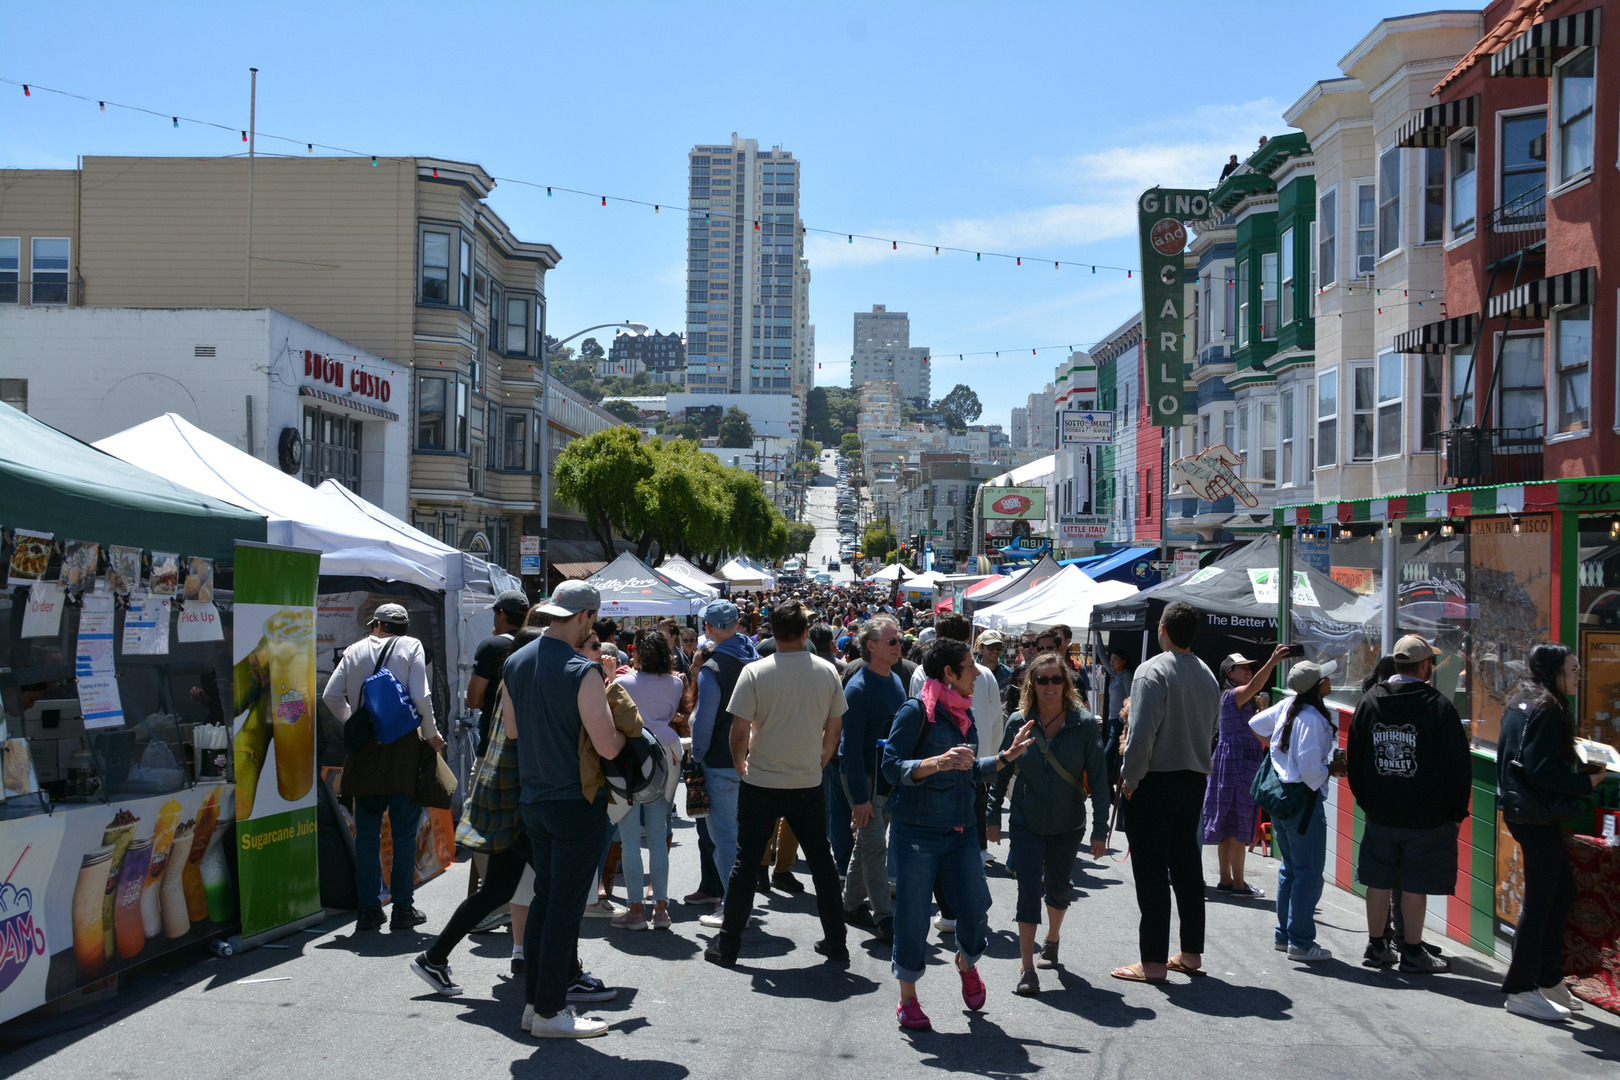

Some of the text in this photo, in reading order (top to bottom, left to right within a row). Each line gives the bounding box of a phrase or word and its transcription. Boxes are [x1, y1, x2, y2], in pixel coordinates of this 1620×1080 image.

[1142, 193, 1208, 214] GINO
[1154, 219, 1185, 246] and
[1158, 264, 1179, 415] CARLO
[305, 350, 391, 402] BUON GUSTO
[1177, 461, 1212, 482] PIZZA
[1200, 454, 1236, 484] GOLDEN
[1577, 482, 1611, 504] 516
[1476, 520, 1548, 535] SAN FRACISCO
[992, 539, 1052, 548] COLMBUS
[32, 600, 54, 613] Order
[182, 612, 214, 623] Pick Up
[1206, 613, 1228, 625] The
[1230, 615, 1266, 628] Better
[277, 700, 308, 718] FOAM
[1373, 731, 1416, 747] ROARING
[1379, 758, 1411, 769] DONKEY
[241, 820, 318, 850] Sugarcane Juice
